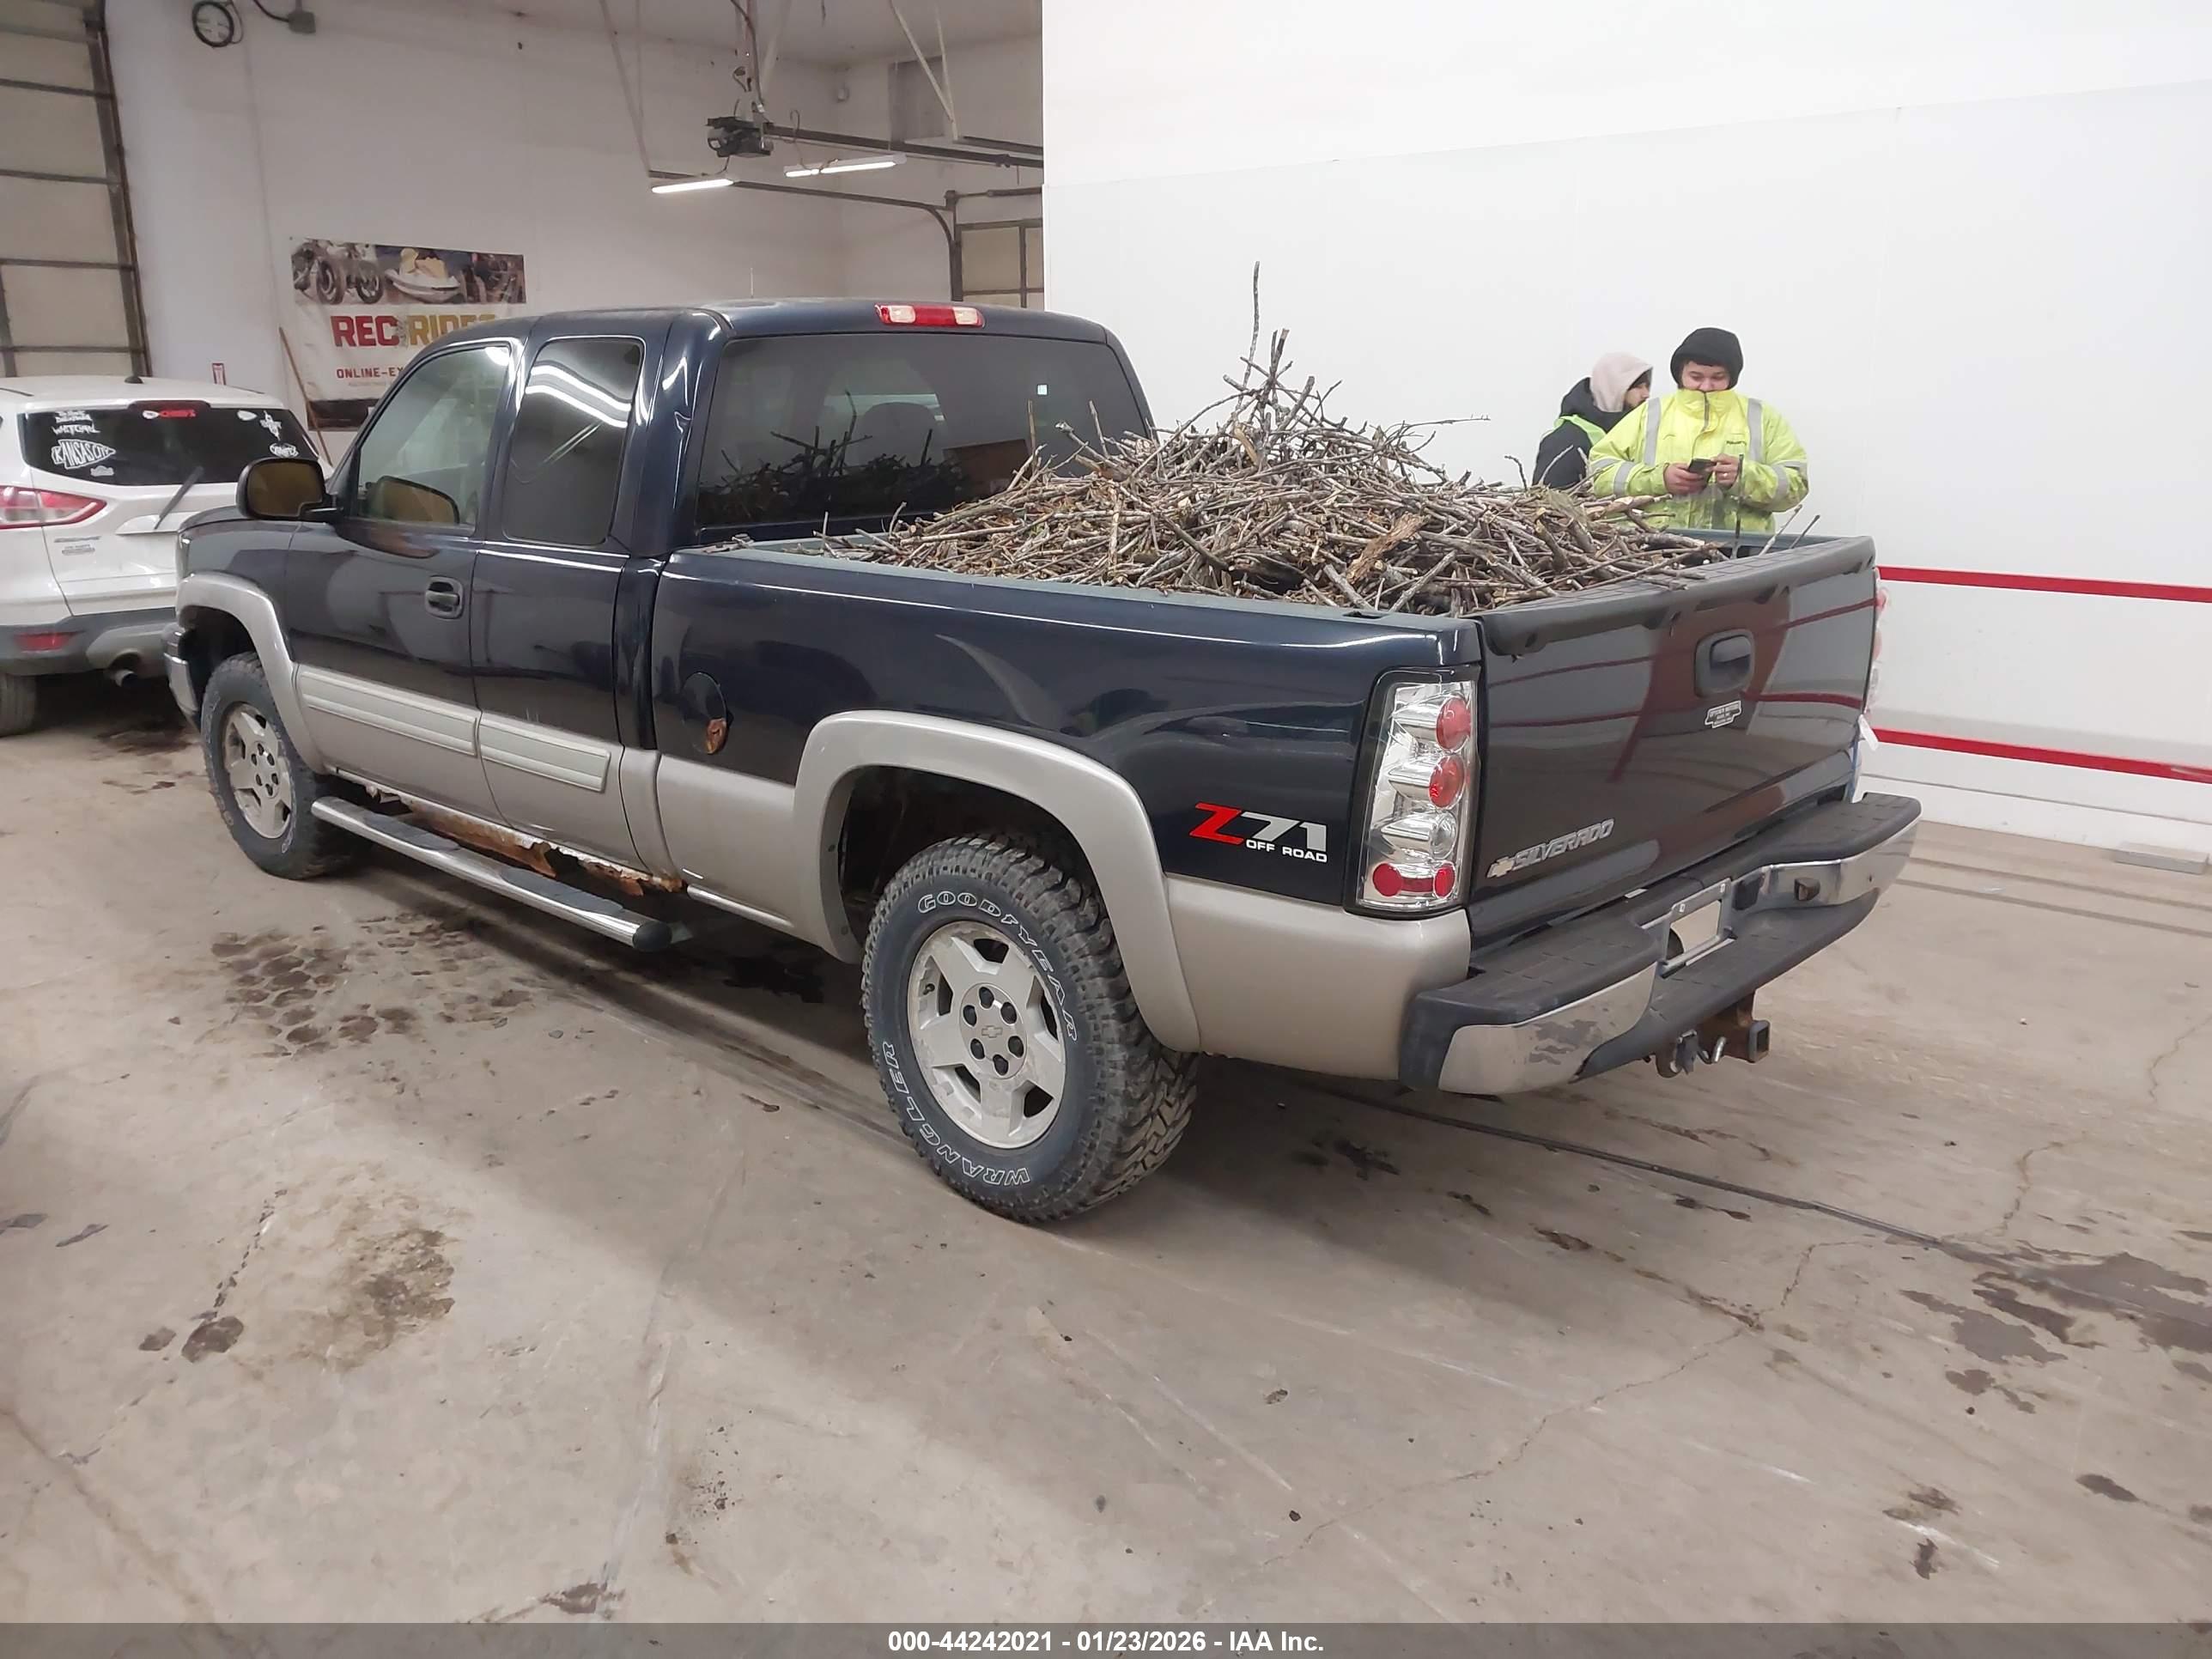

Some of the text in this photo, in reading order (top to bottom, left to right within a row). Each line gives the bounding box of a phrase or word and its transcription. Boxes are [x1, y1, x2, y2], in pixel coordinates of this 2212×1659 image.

[331, 315, 400, 347] REC
[54, 441, 94, 466] KANSAS
[1188, 802, 1328, 853] Z71
[1245, 838, 1328, 863] OFF ROAD
[1511, 818, 1615, 872] SILVERADO
[917, 890, 1078, 1042] GOODYEAR
[882, 1041, 1030, 1186] WRANGLER
